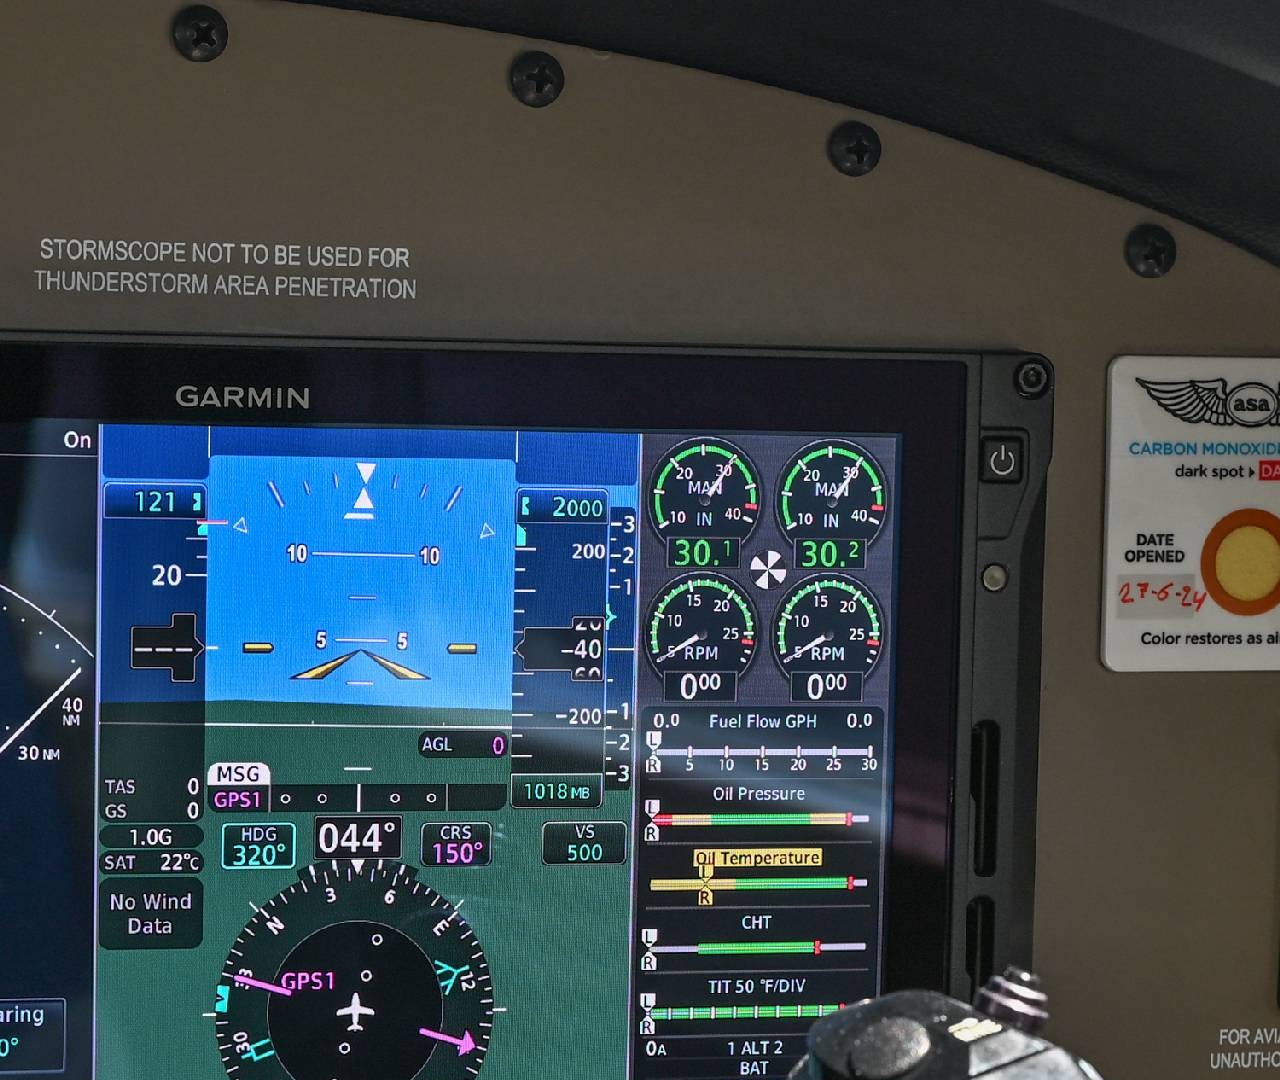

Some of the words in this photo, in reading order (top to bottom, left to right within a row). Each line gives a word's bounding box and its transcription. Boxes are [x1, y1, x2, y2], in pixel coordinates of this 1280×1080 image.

[40, 238, 186, 263] STORMSCOPE
[192, 243, 234, 264] NOT
[241, 244, 268, 265] TO
[274, 245, 301, 265] BE
[308, 247, 361, 267] USED
[368, 248, 409, 268] FOR
[35, 270, 208, 294] THUNDERSTORM
[215, 275, 269, 295] AREA
[275, 276, 416, 299] PENETRATION
[176, 385, 309, 409] GARMIN
[1233, 397, 1269, 411] asa
[64, 431, 91, 449] On
[1129, 443, 1197, 455] CARBON
[1175, 465, 1207, 477] dark
[1212, 466, 1244, 479] spot
[552, 497, 603, 518] 2000
[1136, 534, 1174, 545] DATE
[1125, 551, 1185, 562] OPENED
[1141, 632, 1181, 645] Color
[1186, 633, 1242, 645] restores
[1247, 634, 1262, 644] as
[710, 715, 741, 727] Fuel
[747, 715, 781, 727] Flow
[786, 715, 816, 727] GPH
[216, 766, 259, 782] MSG
[524, 782, 568, 799] 1018
[571, 786, 590, 798] MB
[714, 787, 732, 800] Oil
[739, 787, 805, 800] Pressure
[696, 853, 715, 865] Oil
[721, 852, 819, 867] Temperature
[111, 894, 134, 911] No
[143, 894, 192, 910] Wind
[128, 918, 172, 935] Data
[742, 916, 772, 929] CHT
[1219, 1029, 1250, 1045] FOR
